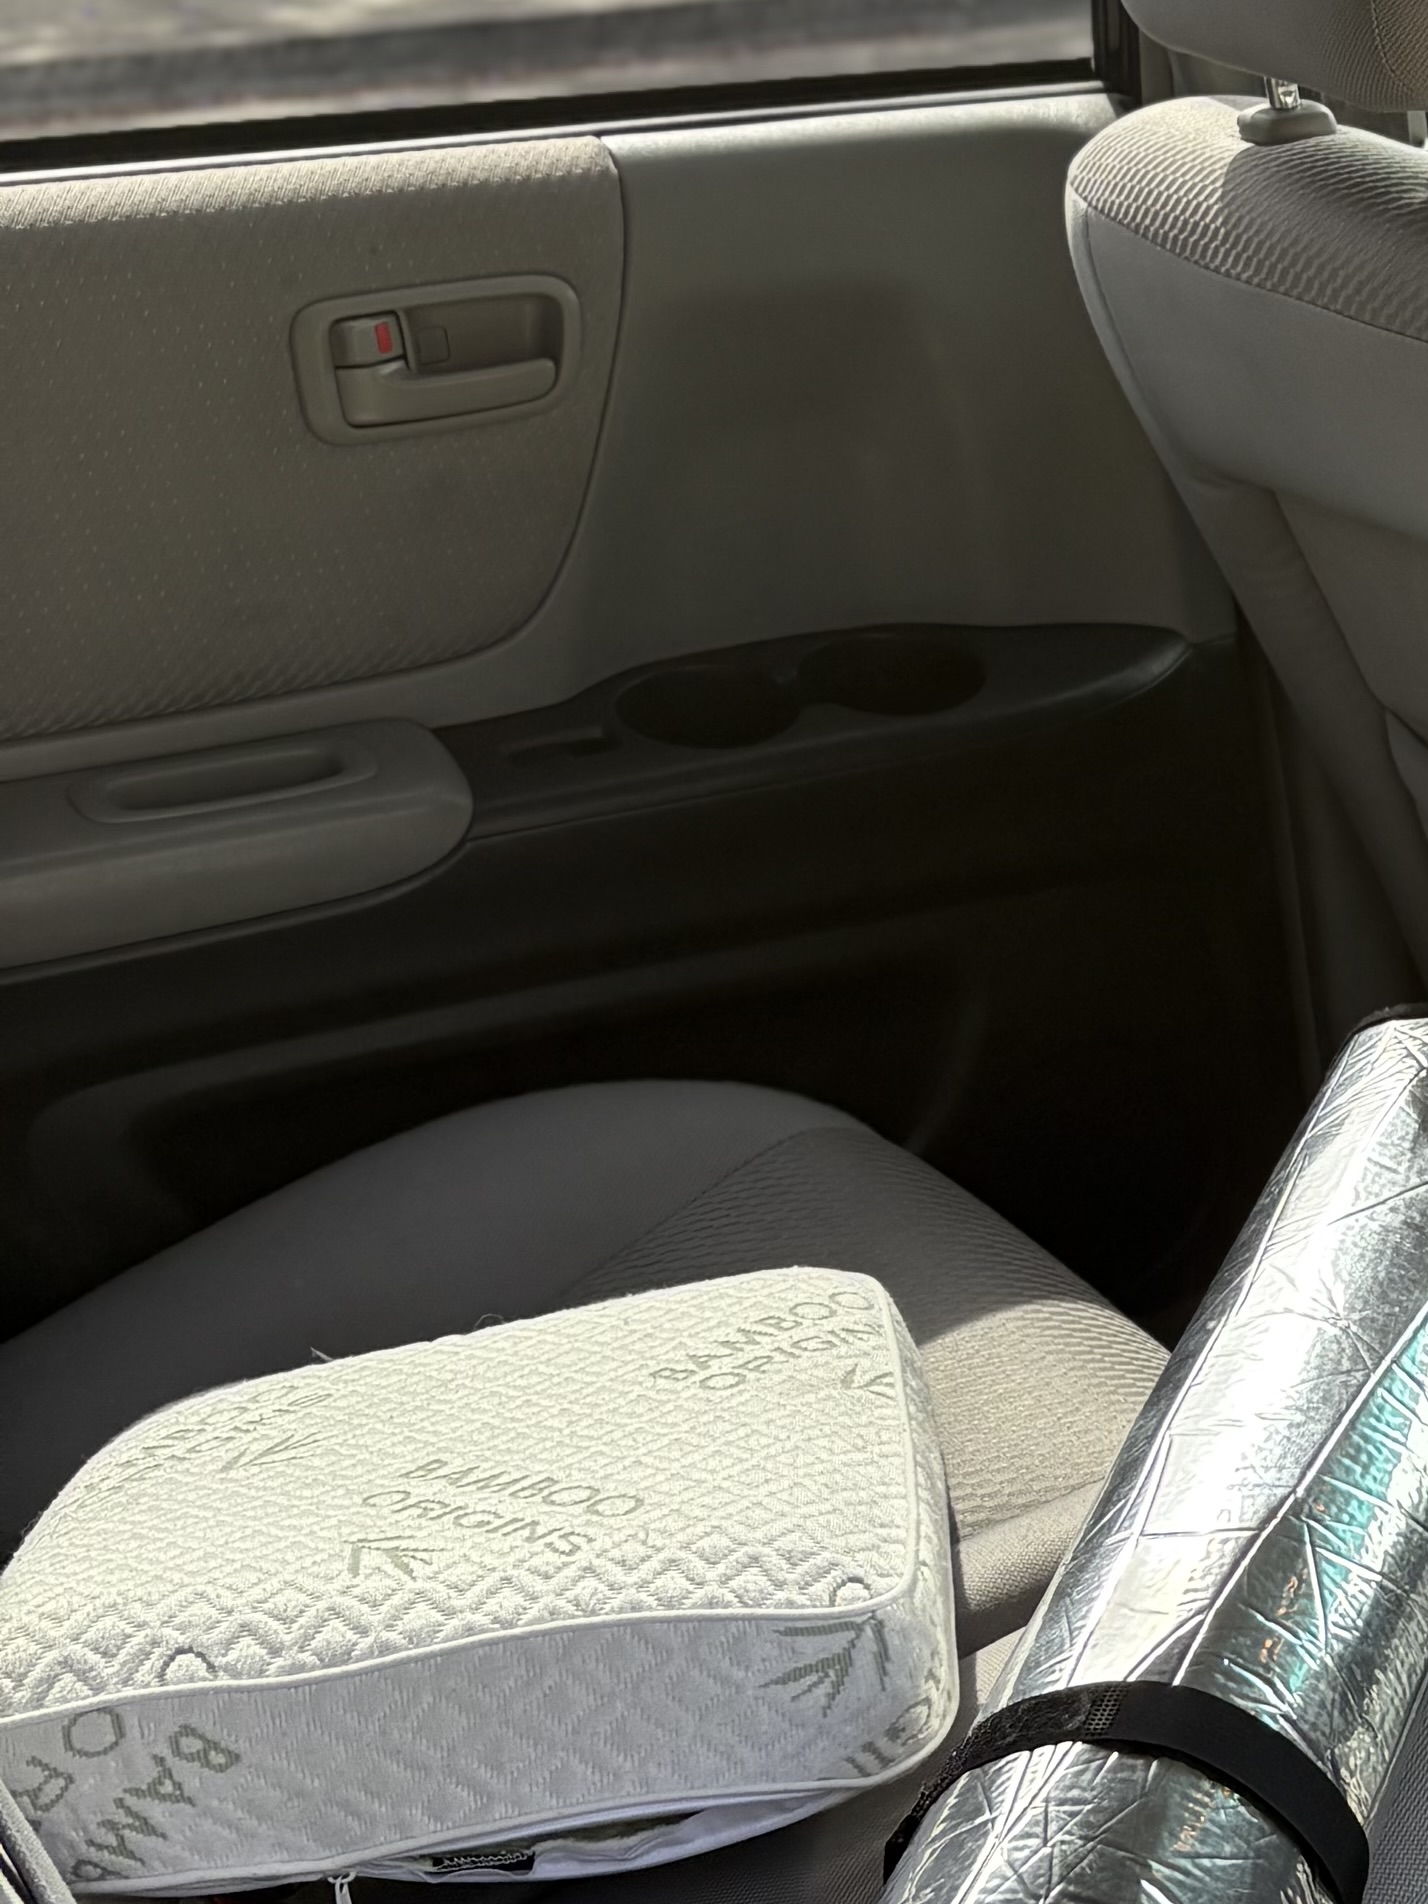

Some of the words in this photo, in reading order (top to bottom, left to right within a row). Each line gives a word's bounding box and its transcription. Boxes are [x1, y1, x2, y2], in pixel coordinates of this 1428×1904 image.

[650, 1291, 874, 1383] BAMBOO
[397, 1458, 646, 1518] BAMBOO
[360, 1489, 597, 1557] ORIGINS
